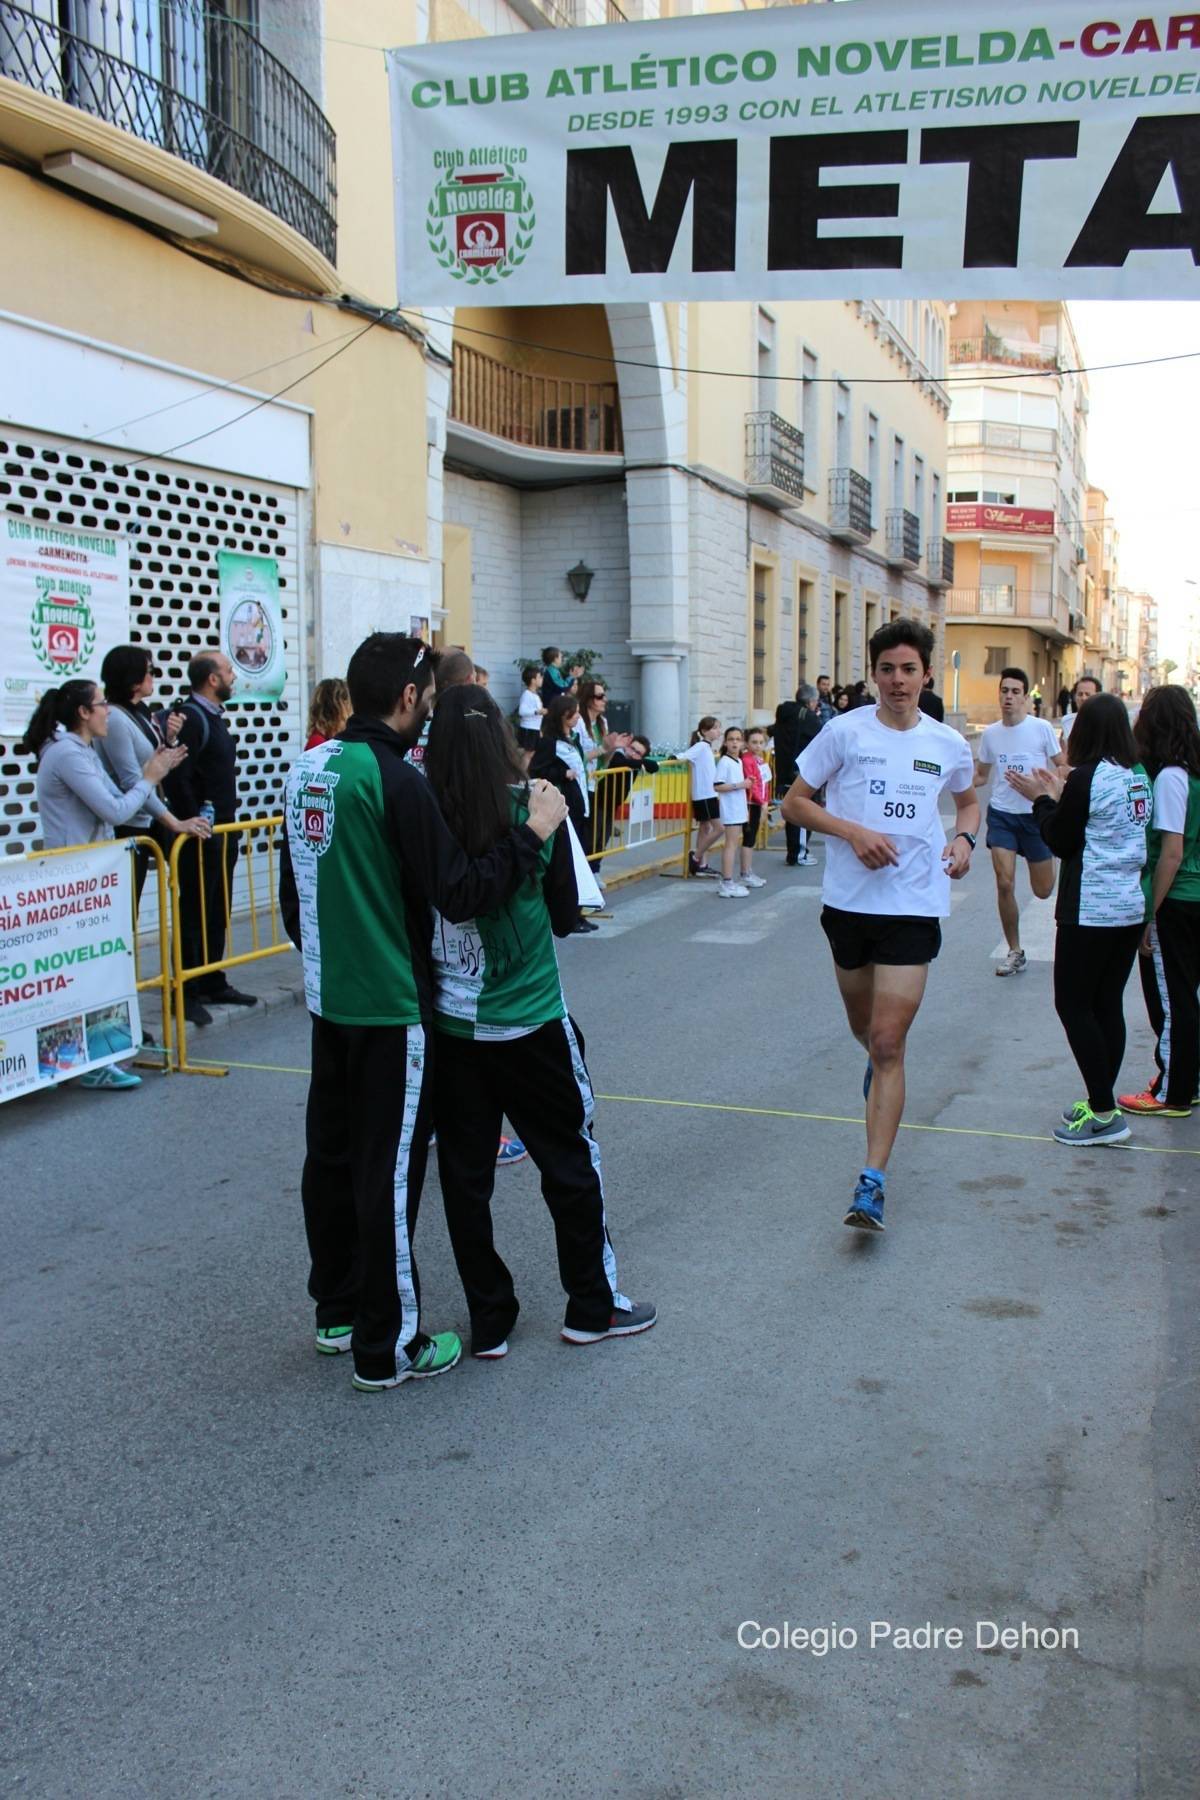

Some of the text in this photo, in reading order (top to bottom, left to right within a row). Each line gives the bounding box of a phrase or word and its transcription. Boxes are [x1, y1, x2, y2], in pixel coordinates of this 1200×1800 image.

[411, 73, 529, 109] CLUB
[546, 52, 777, 98] ATLÉTICO
[567, 73, 1200, 132] DESDE 1993 CON EL ATLETISMO NOVELDE
[433, 146, 528, 169] Club Atlético
[445, 187, 515, 213] Novelda
[565, 114, 1200, 275] META
[883, 801, 916, 819] 503
[17, 878, 98, 908] SANTUARIO
[101, 873, 119, 889] DE
[26, 893, 111, 926] MAGDALENA
[36, 927, 58, 941] 2013
[35, 937, 127, 975] NOVELDA
